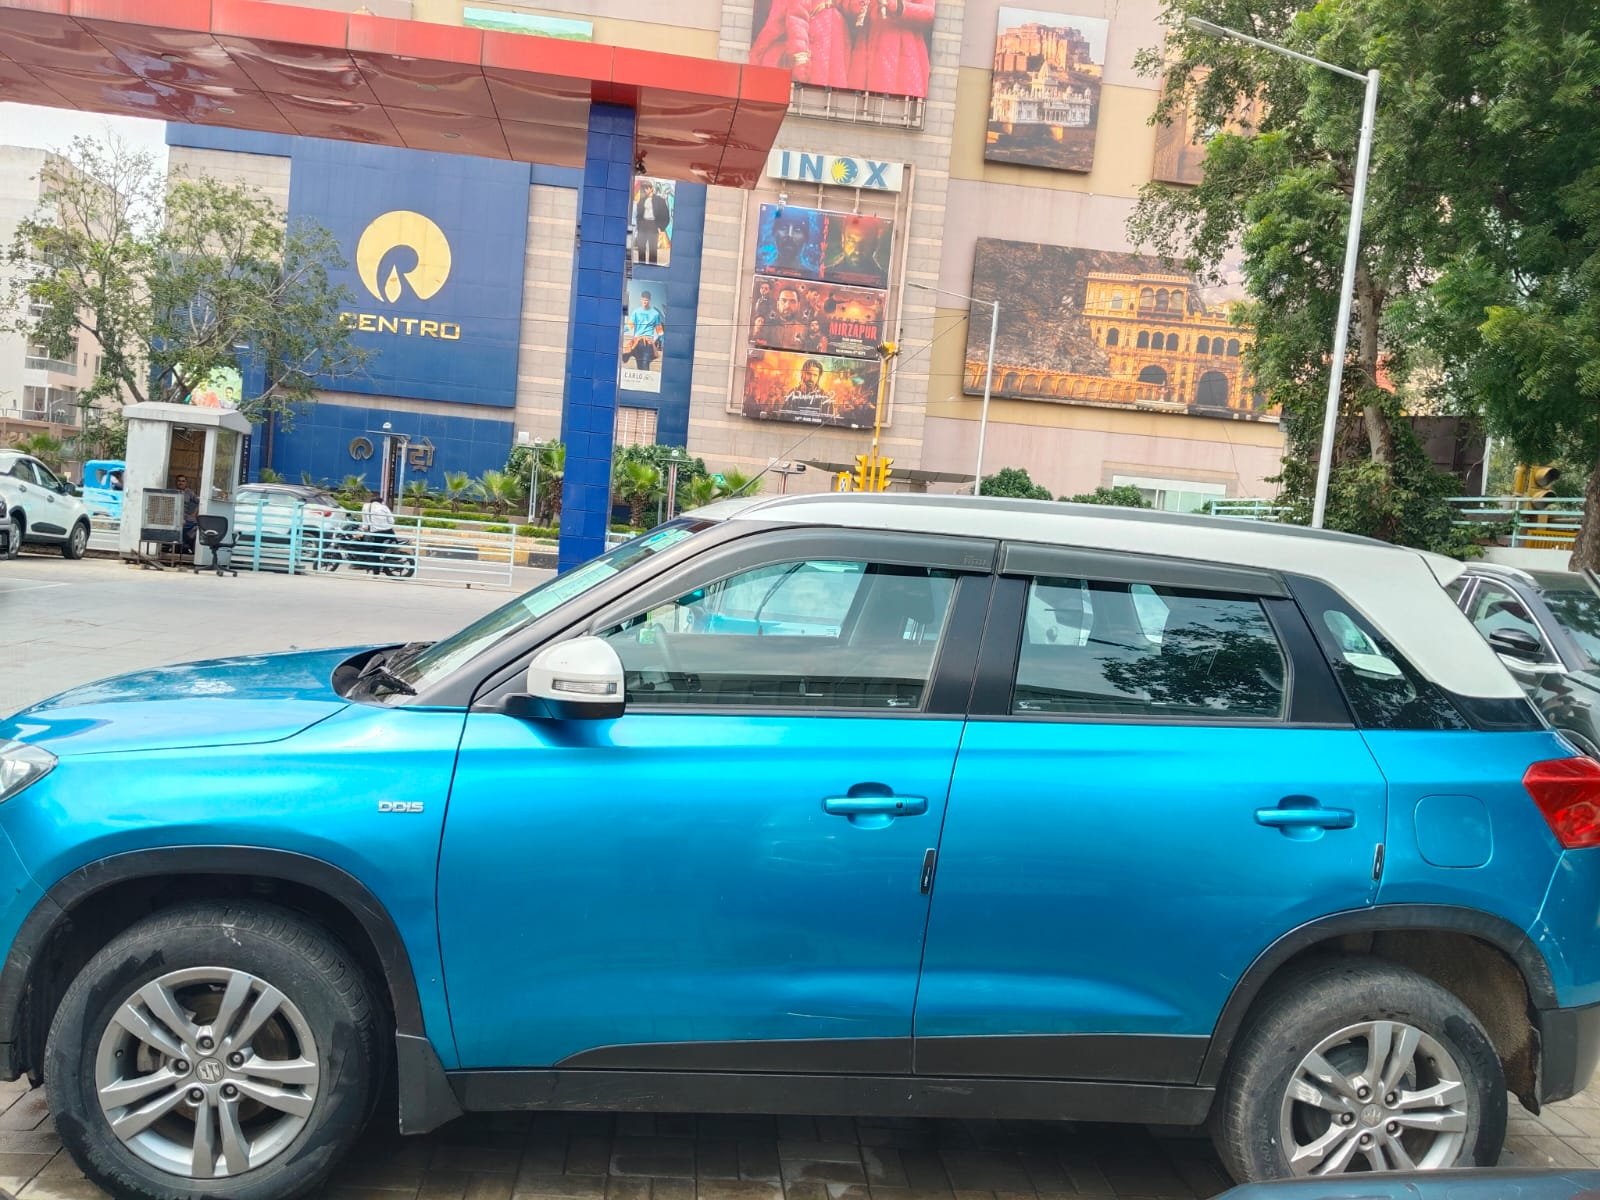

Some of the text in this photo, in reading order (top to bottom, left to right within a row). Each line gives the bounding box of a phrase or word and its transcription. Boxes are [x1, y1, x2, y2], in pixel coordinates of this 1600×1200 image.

[781, 151, 889, 187] INOX
[829, 321, 878, 340] MIRZAPUR
[378, 801, 424, 812] DDIS
